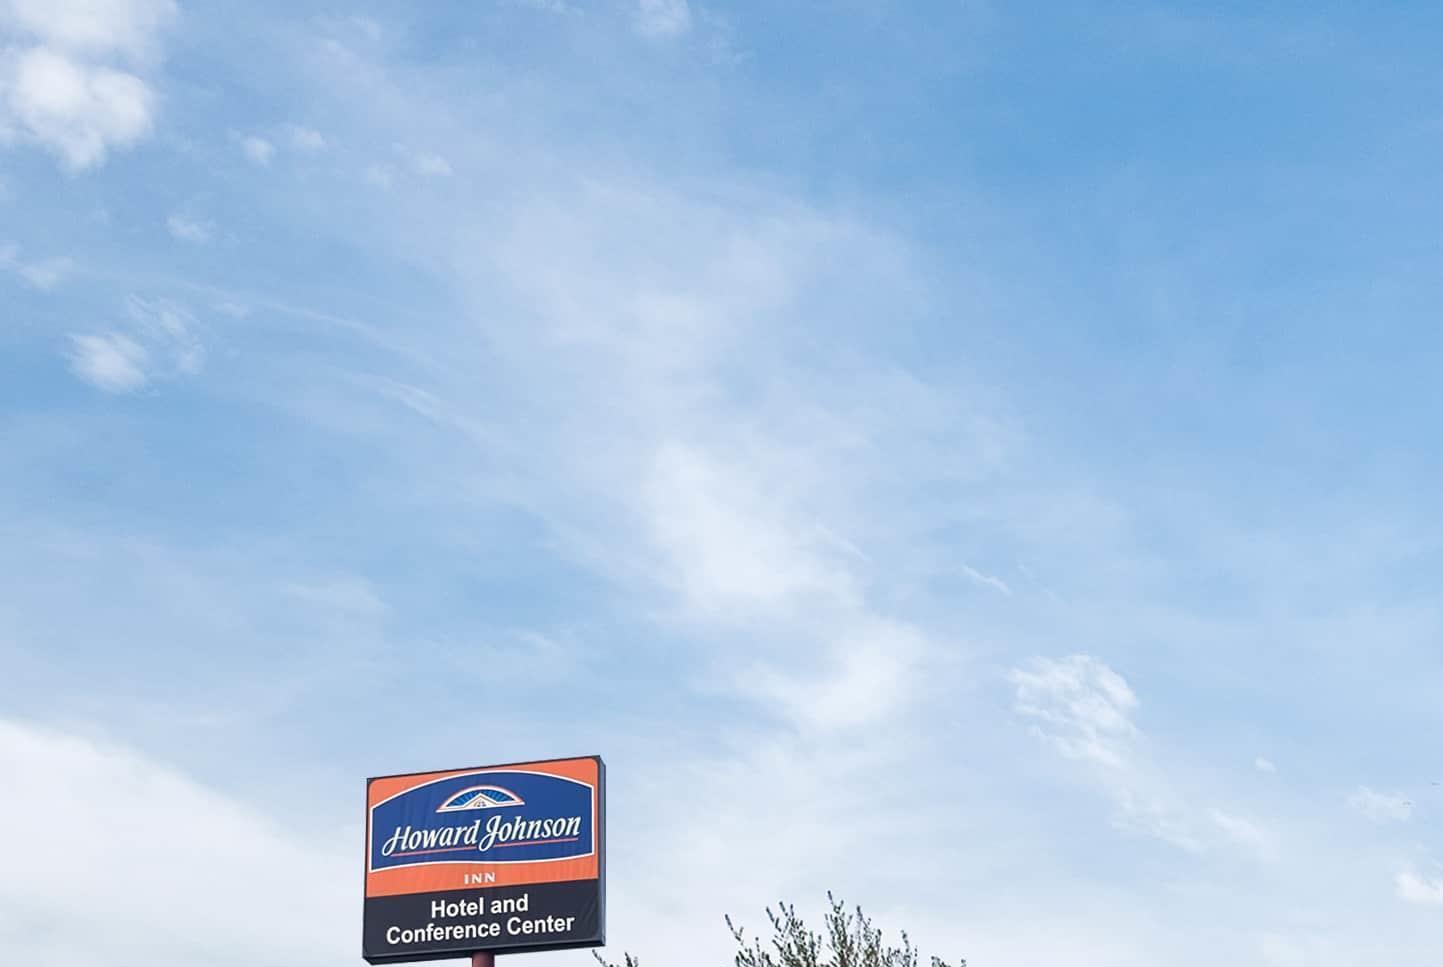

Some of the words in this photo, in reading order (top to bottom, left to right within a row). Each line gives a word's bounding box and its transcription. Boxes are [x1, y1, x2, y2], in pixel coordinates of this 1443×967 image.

[382, 819, 480, 856] Howard
[478, 815, 582, 851] Johnson
[464, 872, 496, 884] INN
[431, 897, 484, 918] Hotel
[490, 893, 529, 914] and
[386, 922, 501, 944] Conference
[506, 915, 575, 935] Center
